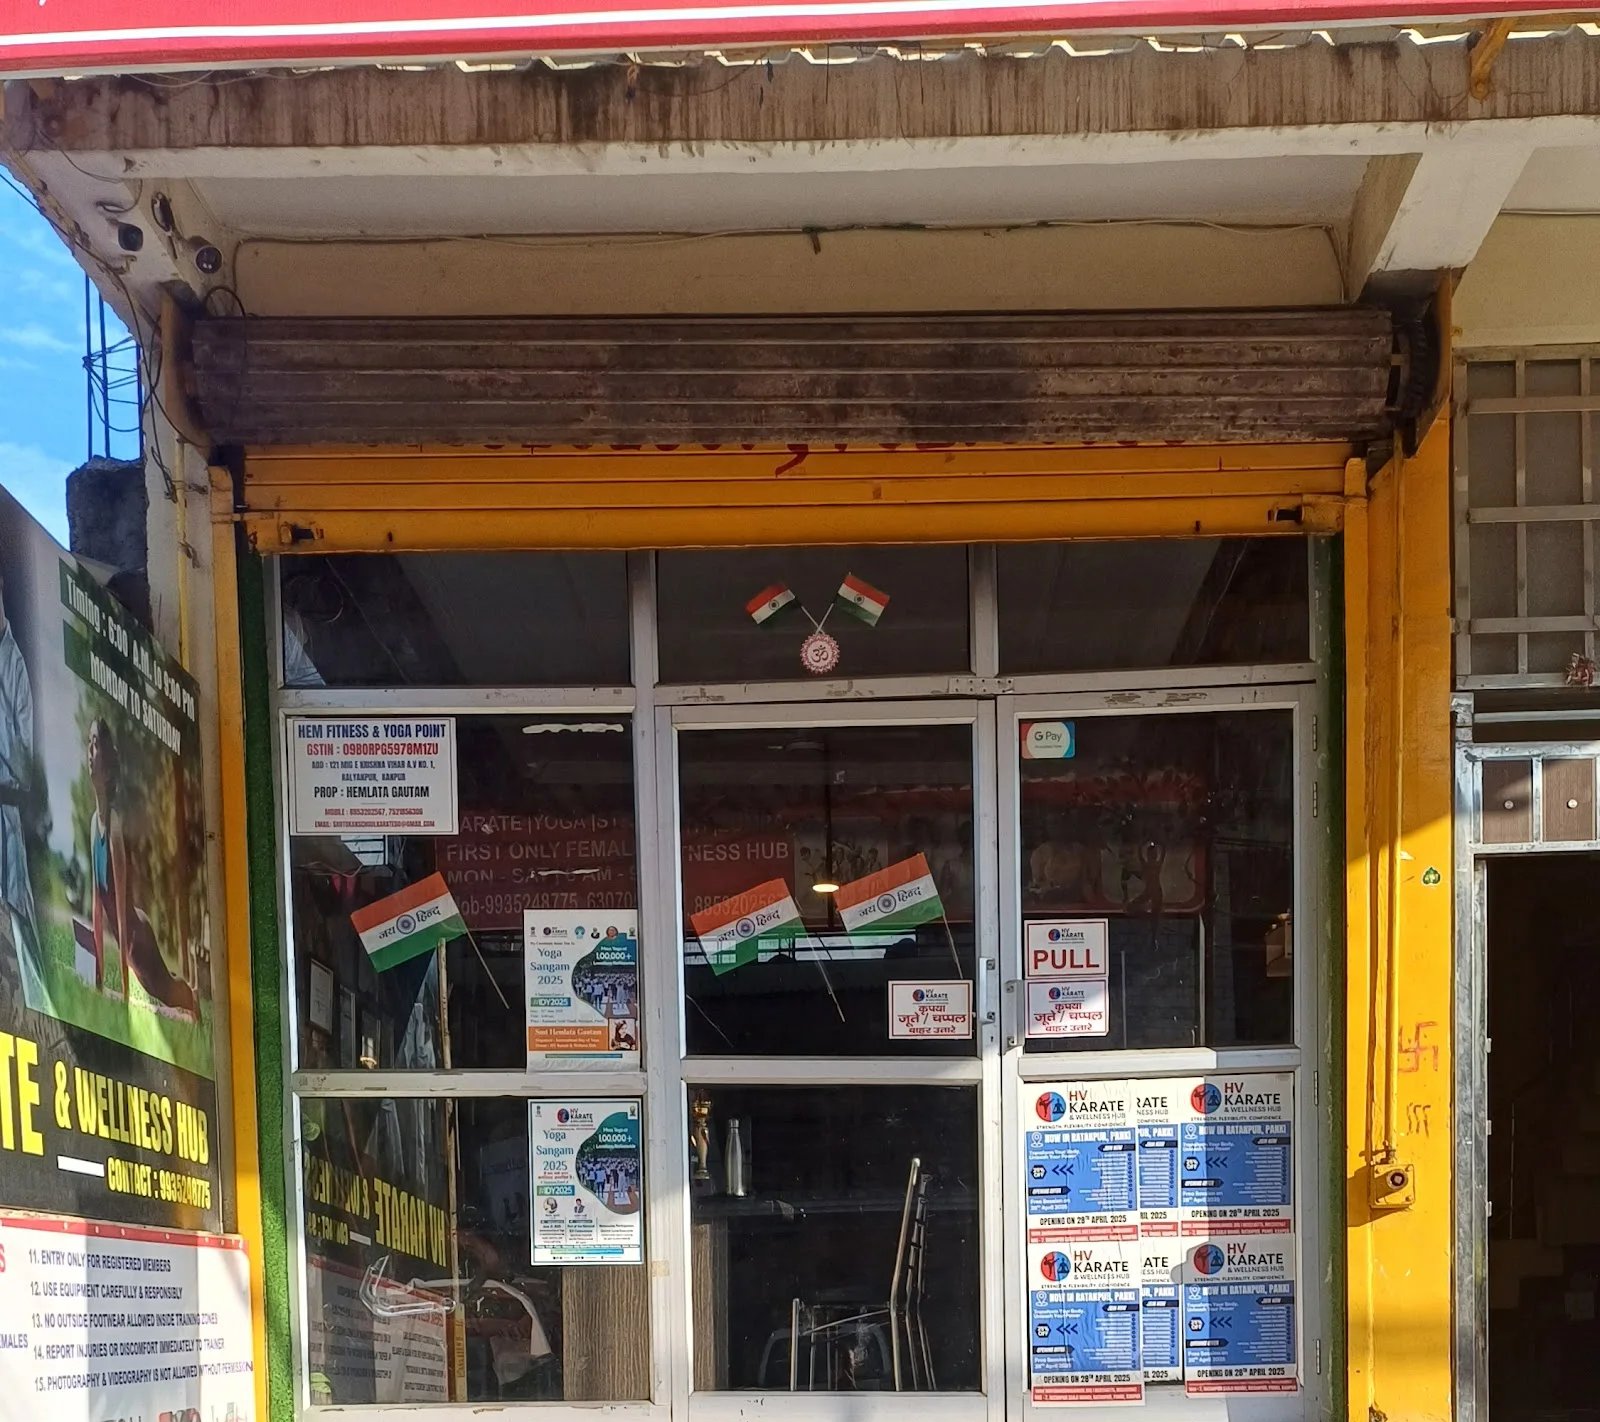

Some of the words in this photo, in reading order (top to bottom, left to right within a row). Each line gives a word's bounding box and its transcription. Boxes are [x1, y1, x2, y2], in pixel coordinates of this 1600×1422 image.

[67, 574, 100, 633] Timing
[108, 616, 128, 657] 6:00
[164, 671, 181, 708] 9:00
[182, 688, 195, 722] PM
[90, 651, 128, 709] MONDAY
[129, 687, 140, 720] TO
[142, 699, 181, 755] SATURDAY
[298, 724, 323, 738] HEM
[327, 724, 369, 738] FITNESS
[372, 725, 380, 738] &
[383, 724, 412, 738] YOGA
[415, 724, 446, 738] POINT
[1045, 731, 1062, 742] Pay
[307, 743, 334, 756] GSTIN
[314, 786, 338, 798] PROP
[346, 786, 389, 798] HEMLATA
[392, 786, 430, 798] GAUTAM
[510, 841, 561, 859] ONLY
[747, 842, 789, 860] HUB
[537, 948, 562, 959] Yoga
[1033, 948, 1100, 970] PULL
[530, 962, 570, 972] Sangam
[537, 975, 563, 985] 2025
[918, 1004, 946, 1015] कृपया
[1054, 1002, 1082, 1013] कृपया
[898, 1012, 920, 1027] जूते
[932, 1014, 966, 1023] चप्पल
[1033, 1010, 1056, 1025] जूते
[1068, 1011, 1103, 1020] चप्पल
[1224, 1082, 1244, 1093] HV
[1069, 1090, 1088, 1101] HV
[1225, 1093, 1281, 1105] KARATE
[54, 1060, 72, 1129] &
[74, 1066, 173, 1155] WELLNESS
[176, 1101, 209, 1164] HUB
[1070, 1100, 1124, 1113] KARATE
[543, 1130, 566, 1141] Yoga
[536, 1145, 574, 1157] Sangam
[543, 1160, 568, 1171] 2025
[107, 1156, 152, 1197] CONTACT
[1151, 1211, 1167, 1219] 2025
[1192, 1210, 1217, 1218] OPENING
[1244, 1209, 1261, 1217] APRIL
[1040, 1217, 1065, 1225] OPENING
[1091, 1215, 1108, 1223] APRIL
[1110, 1215, 1127, 1223] 2025
[1227, 1243, 1246, 1254] HV
[29, 1248, 40, 1264] 11.
[42, 1250, 66, 1265] ENTRY
[67, 1252, 86, 1267] ONLY
[87, 1254, 101, 1268] FOR
[102, 1255, 141, 1271] REGISTERED
[143, 1258, 171, 1272] MEMBERS
[1074, 1250, 1093, 1261] HV
[1228, 1253, 1283, 1265] KARATE
[1074, 1261, 1129, 1273] KARATE
[1144, 1257, 1168, 1268] ATE
[30, 1281, 41, 1296] 12.
[43, 1282, 58, 1297] USE
[60, 1282, 99, 1298] EQUIPMENT
[101, 1284, 137, 1299] CAREFULLY
[145, 1287, 182, 1300] RESPONSIBLY
[32, 1313, 43, 1328] 13.
[44, 1313, 55, 1328] NO
[57, 1313, 89, 1328] OUTSIDE
[89, 1313, 126, 1328] FOOTWEAR
[127, 1313, 155, 1327] ALLOWED
[156, 1313, 175, 1327] INSIDE
[176, 1313, 200, 1326] TRAINING
[33, 1345, 44, 1360] 14.
[46, 1344, 75, 1360] REPORT
[76, 1343, 107, 1359] INJURIES
[109, 1343, 119, 1357] OR
[120, 1341, 158, 1356] DISCOMFORT
[160, 1339, 194, 1354] IMMEDIATELY
[195, 1339, 202, 1351] TO
[35, 1377, 46, 1392] 15.
[47, 1372, 100, 1391] PHOTOGRAPHY
[102, 1372, 107, 1386] &
[108, 1368, 151, 1386] VIDEOGRAPHY
[153, 1368, 159, 1382] IS
[160, 1367, 171, 1381] NOT
[172, 1365, 198, 1379] ALLOWED
[1095, 1375, 1112, 1383] APRIL
[1114, 1374, 1131, 1382] 2025
[1151, 1370, 1168, 1378] 2025
[1197, 1369, 1223, 1377] OPENING
[1249, 1368, 1266, 1376] APRIL
